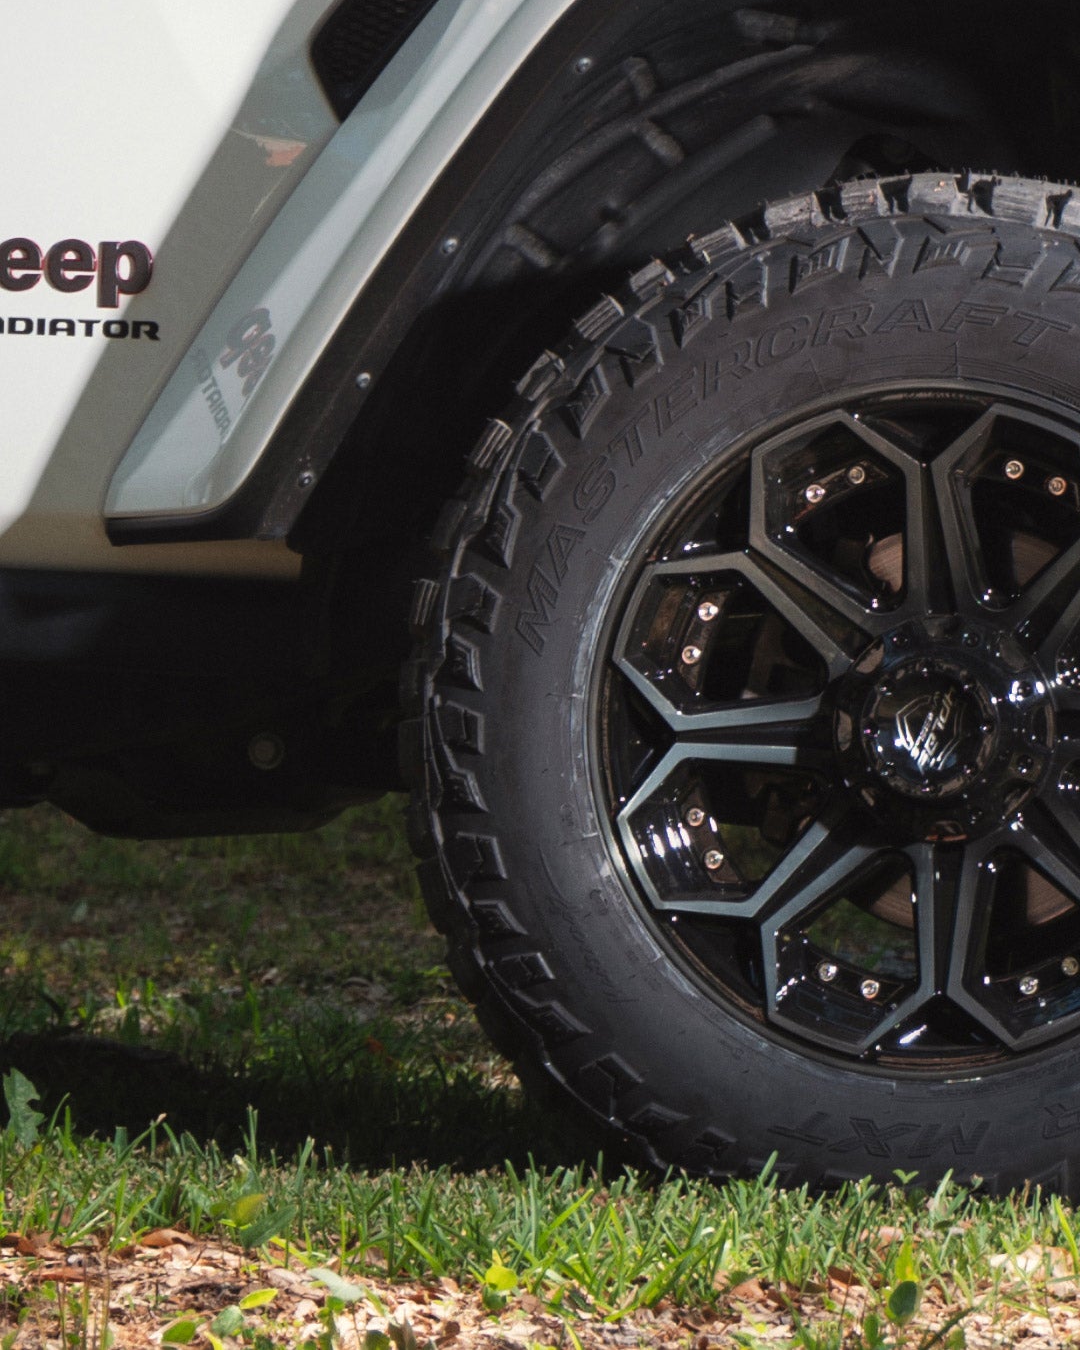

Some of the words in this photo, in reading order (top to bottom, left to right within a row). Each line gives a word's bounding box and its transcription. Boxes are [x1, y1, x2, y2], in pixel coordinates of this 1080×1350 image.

[0, 316, 161, 341] DIATOR
[515, 298, 1074, 656] MASTERCRAFT
[767, 1111, 991, 1159] MXT
